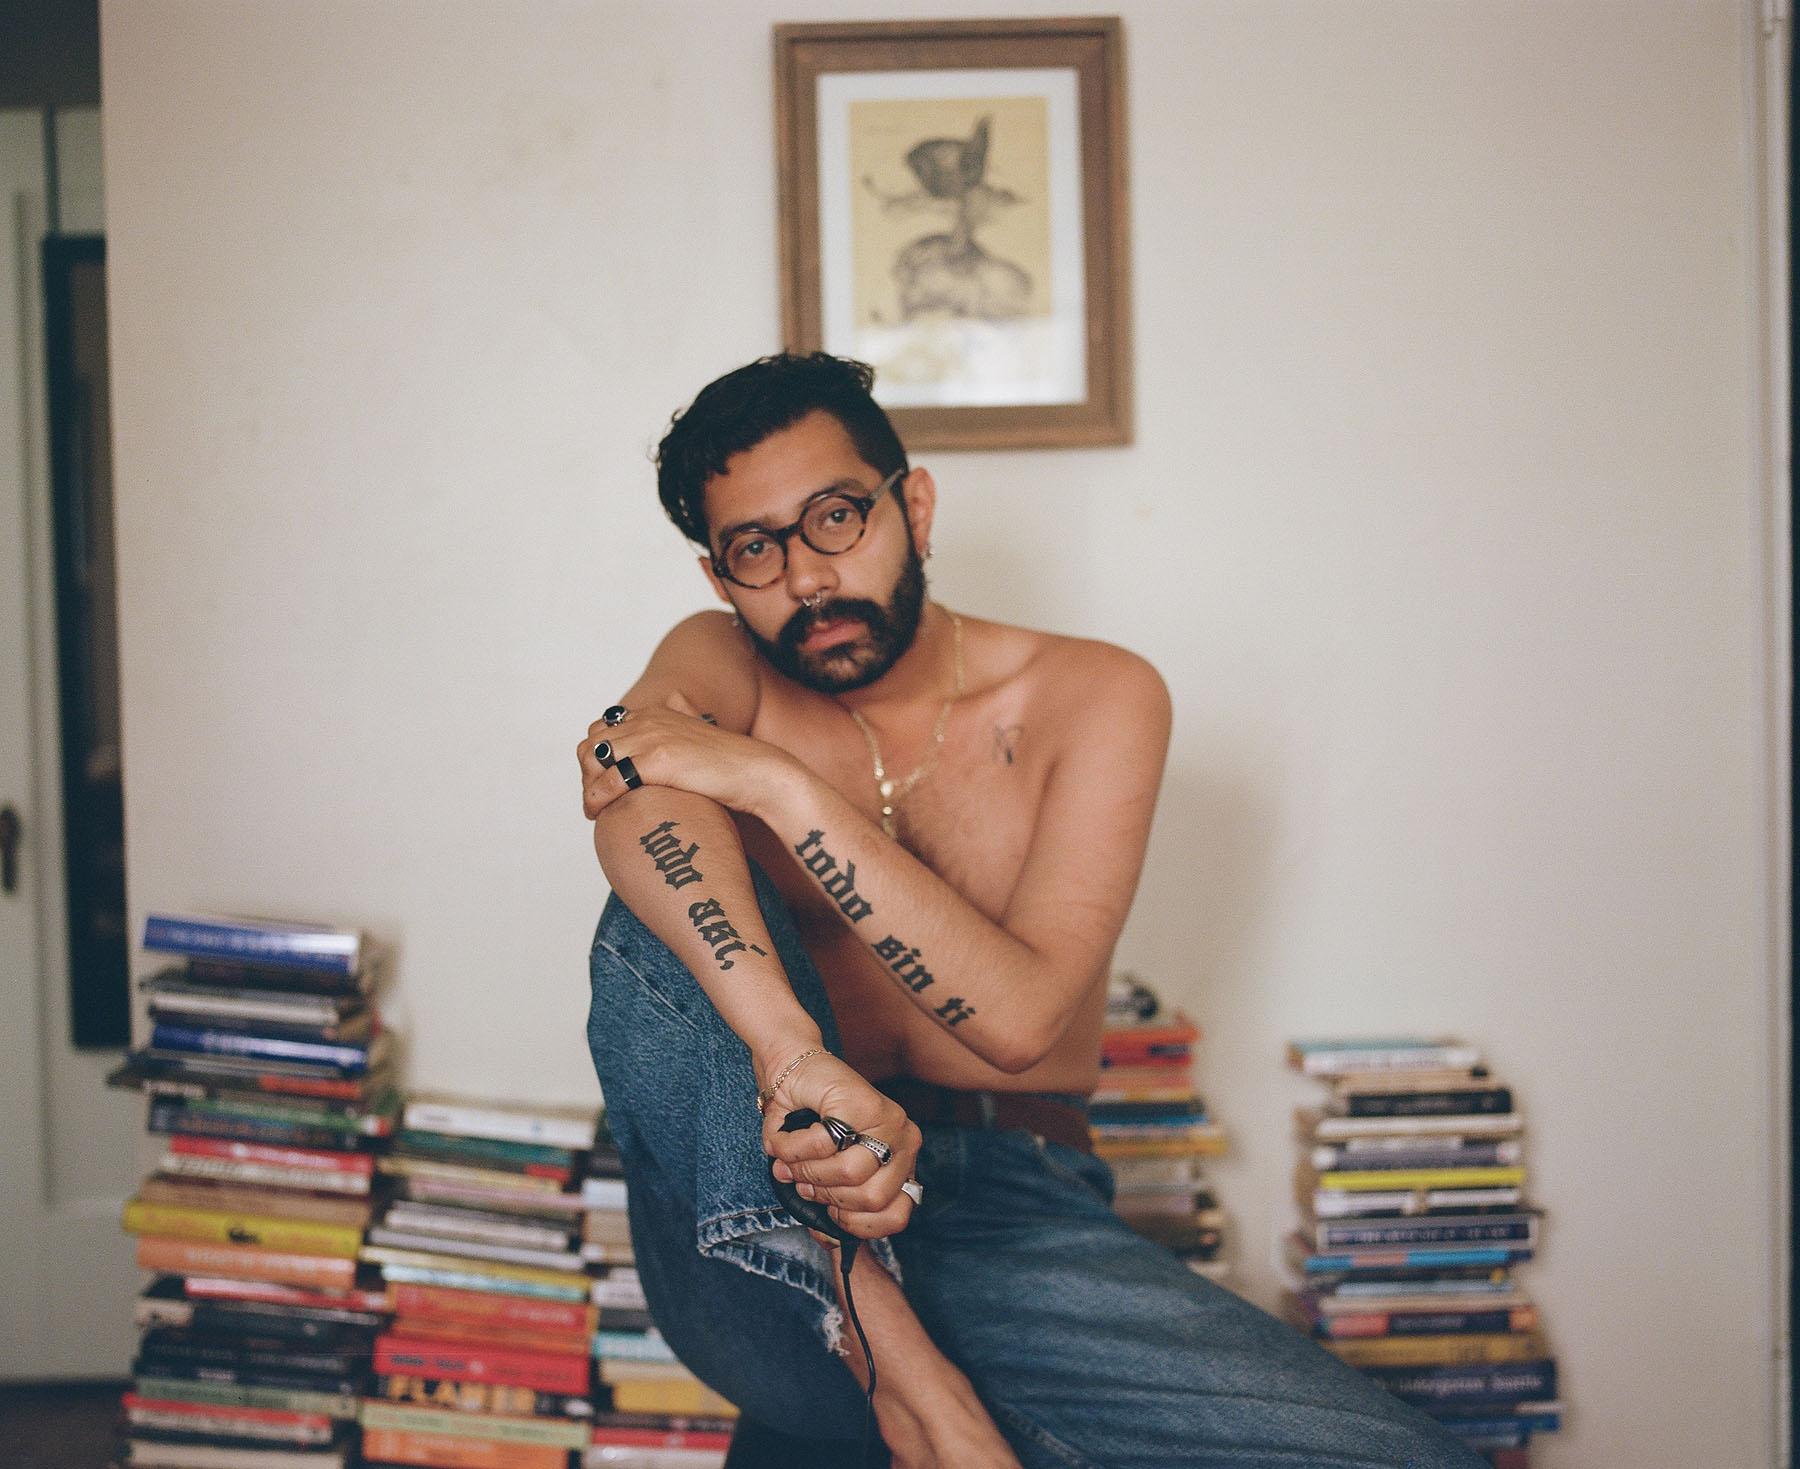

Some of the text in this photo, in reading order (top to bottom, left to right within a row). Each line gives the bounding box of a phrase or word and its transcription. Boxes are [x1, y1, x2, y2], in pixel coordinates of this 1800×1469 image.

[640, 821, 703, 890] todo
[795, 829, 976, 1027] todo sin ti
